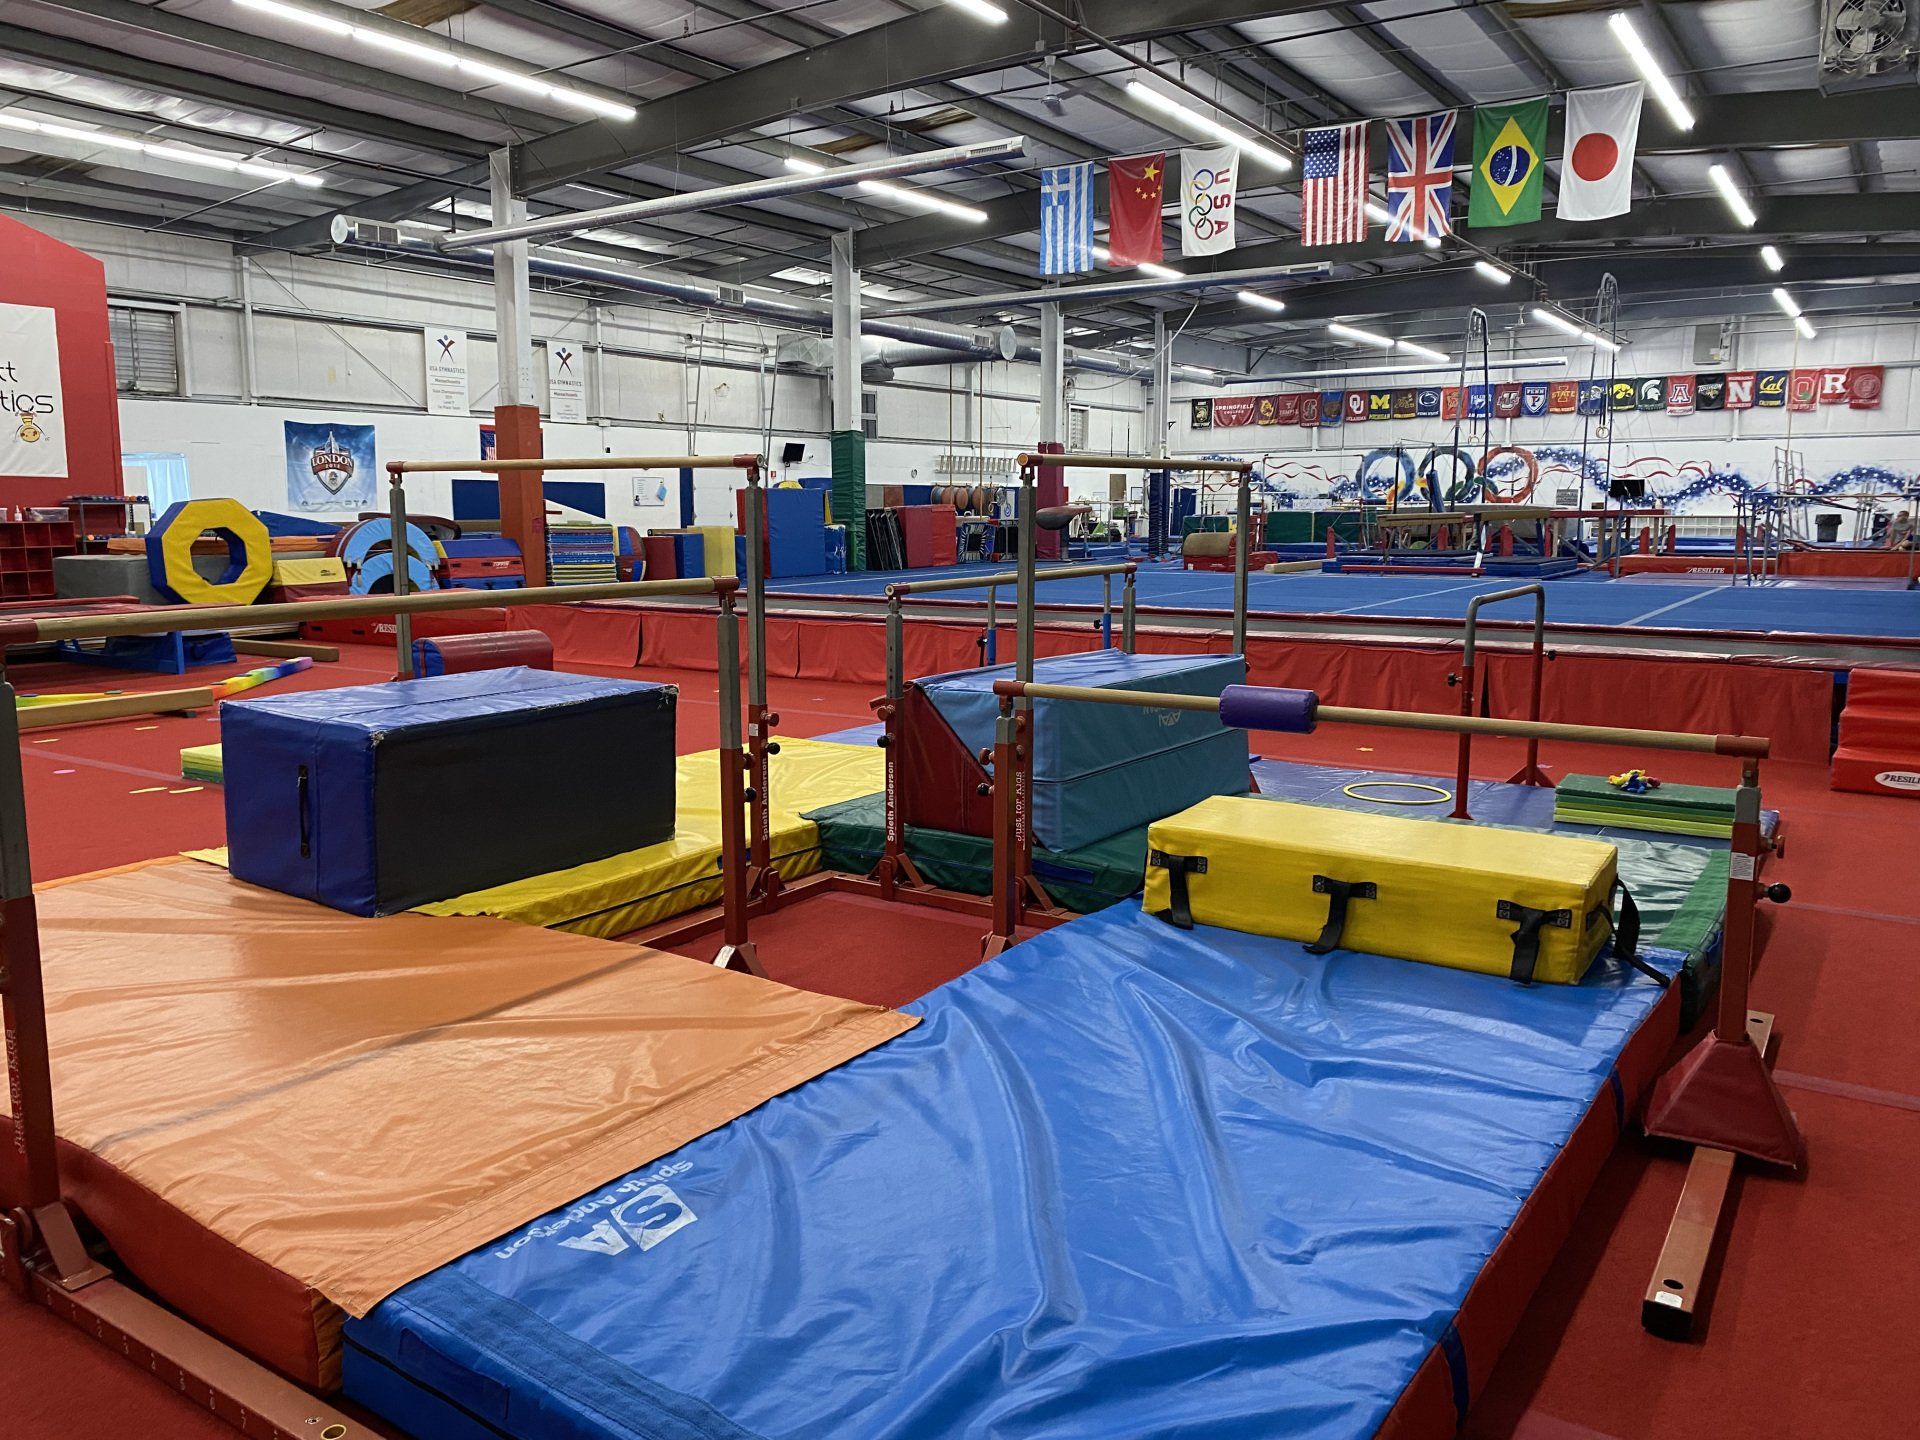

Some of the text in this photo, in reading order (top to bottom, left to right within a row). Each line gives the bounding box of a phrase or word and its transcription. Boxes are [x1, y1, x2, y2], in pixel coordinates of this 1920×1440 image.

[1213, 168, 1231, 235] USA
[1669, 384, 1691, 404] A
[1728, 381, 1752, 403] N
[1760, 376, 1786, 392] Cal
[1822, 374, 1847, 394] R
[1370, 394, 1390, 410] M
[311, 454, 353, 466] LONDON
[887, 811, 895, 842] Spieth
[495, 1195, 617, 1259] Anderson
